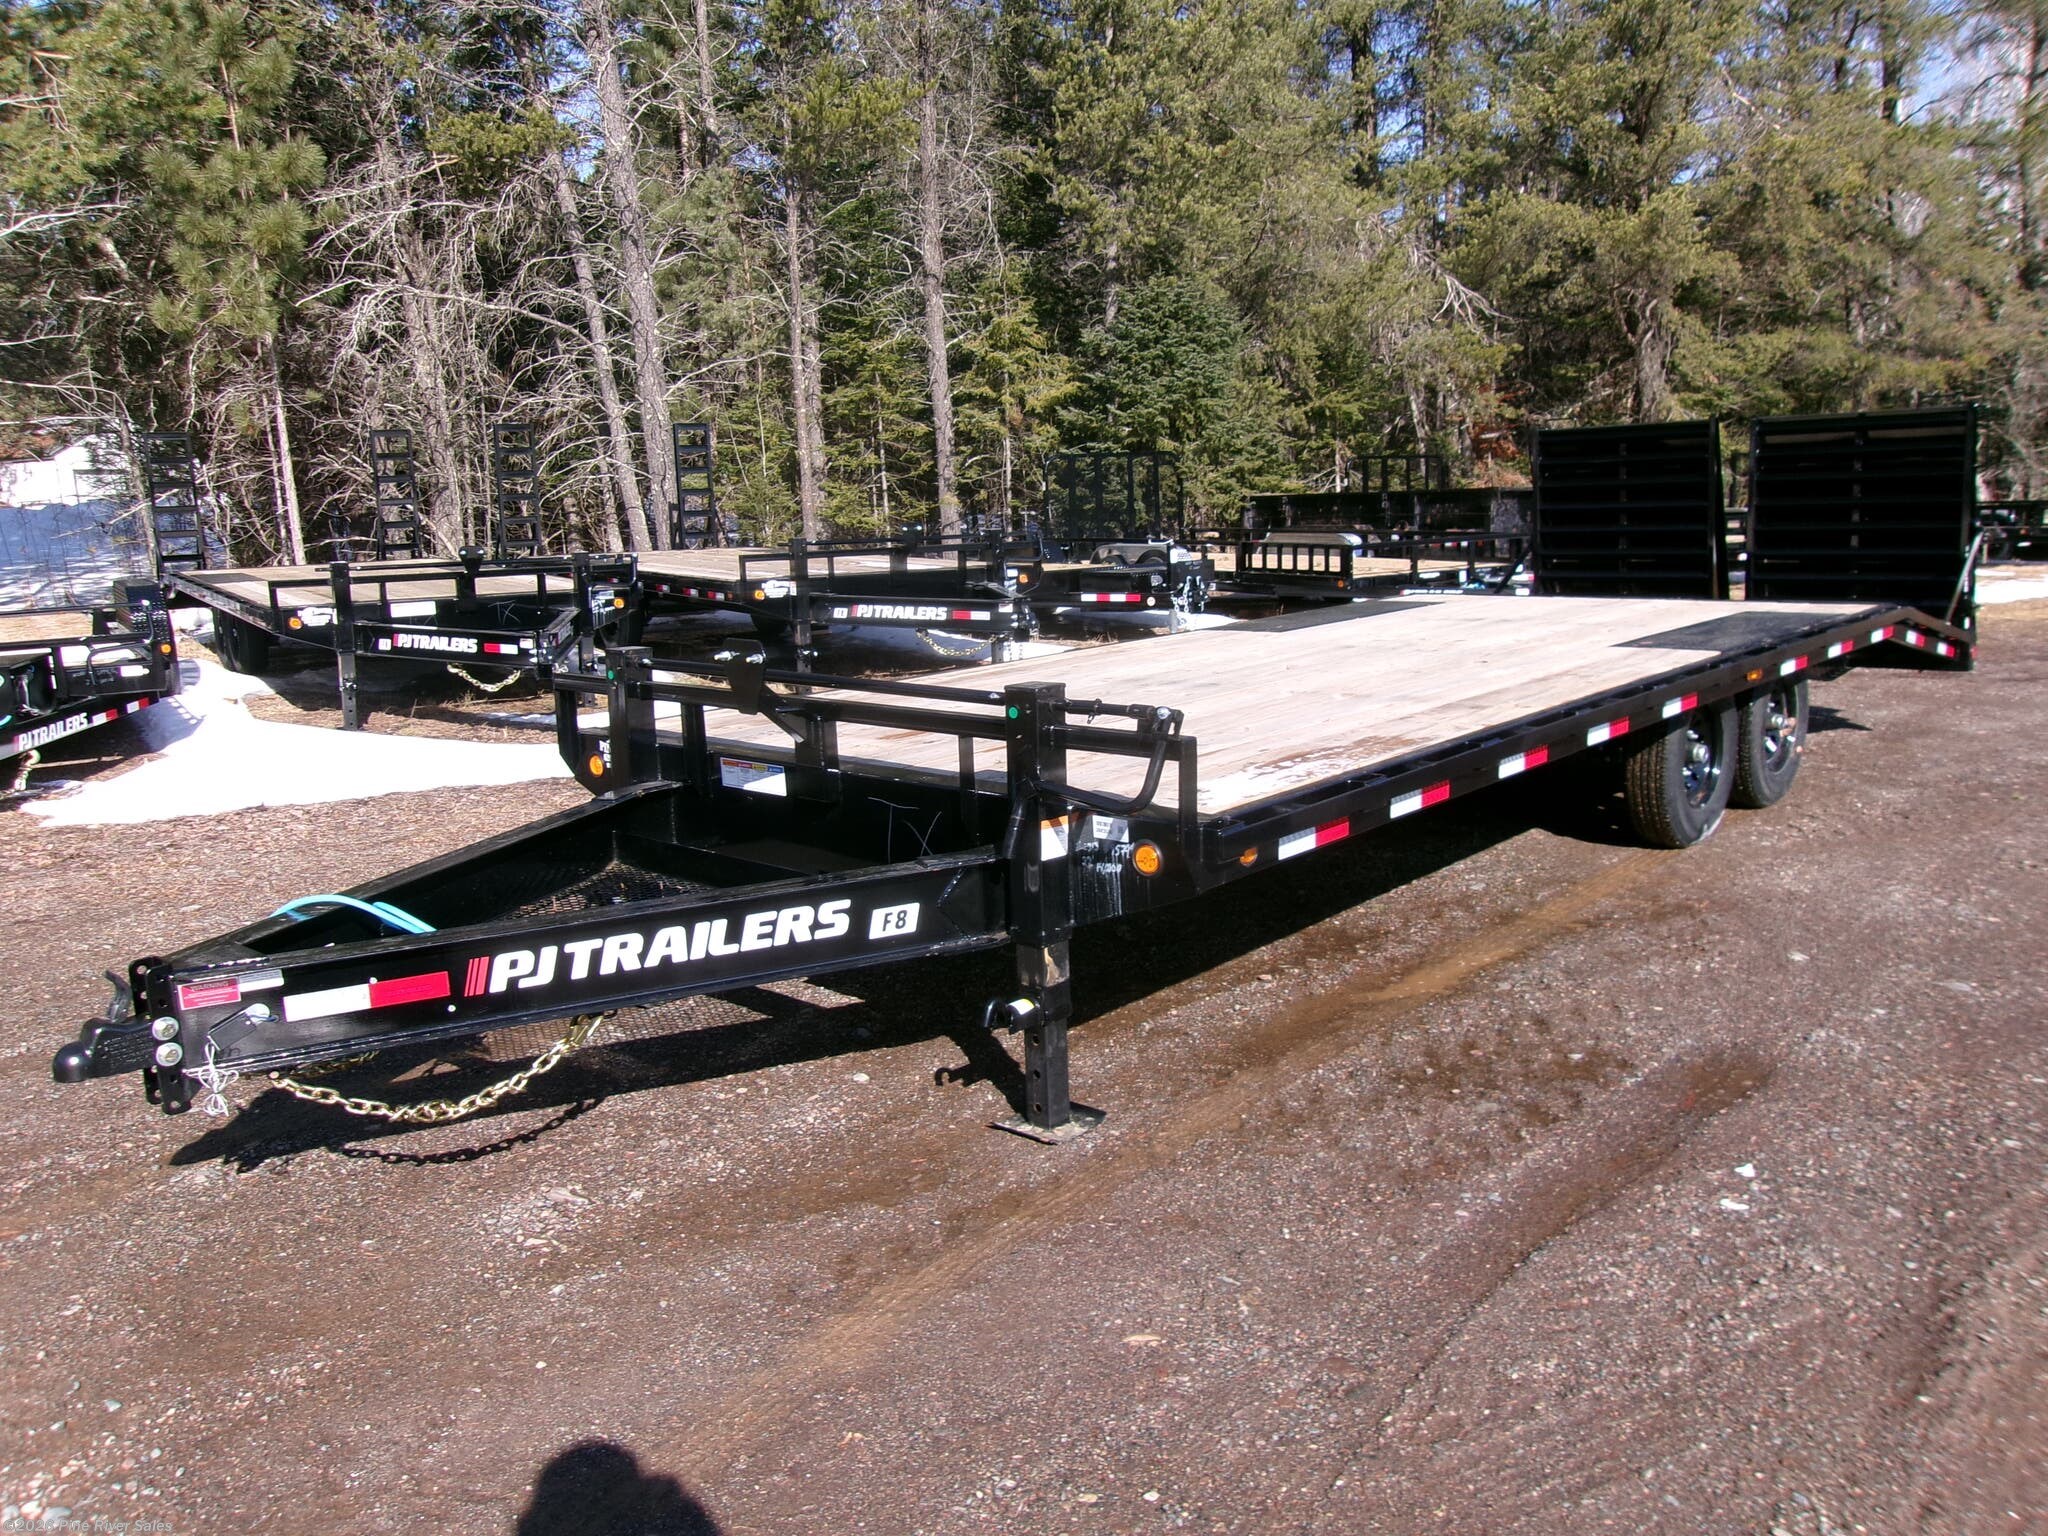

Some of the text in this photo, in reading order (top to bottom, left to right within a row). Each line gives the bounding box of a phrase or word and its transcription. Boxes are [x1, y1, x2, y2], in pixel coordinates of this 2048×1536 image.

[873, 604, 947, 620] TRAILERS
[412, 634, 478, 654] TRAILERS
[32, 711, 89, 747] TRAILERS
[882, 909, 908, 932] F8
[489, 899, 852, 993] PJ TRAILERS
